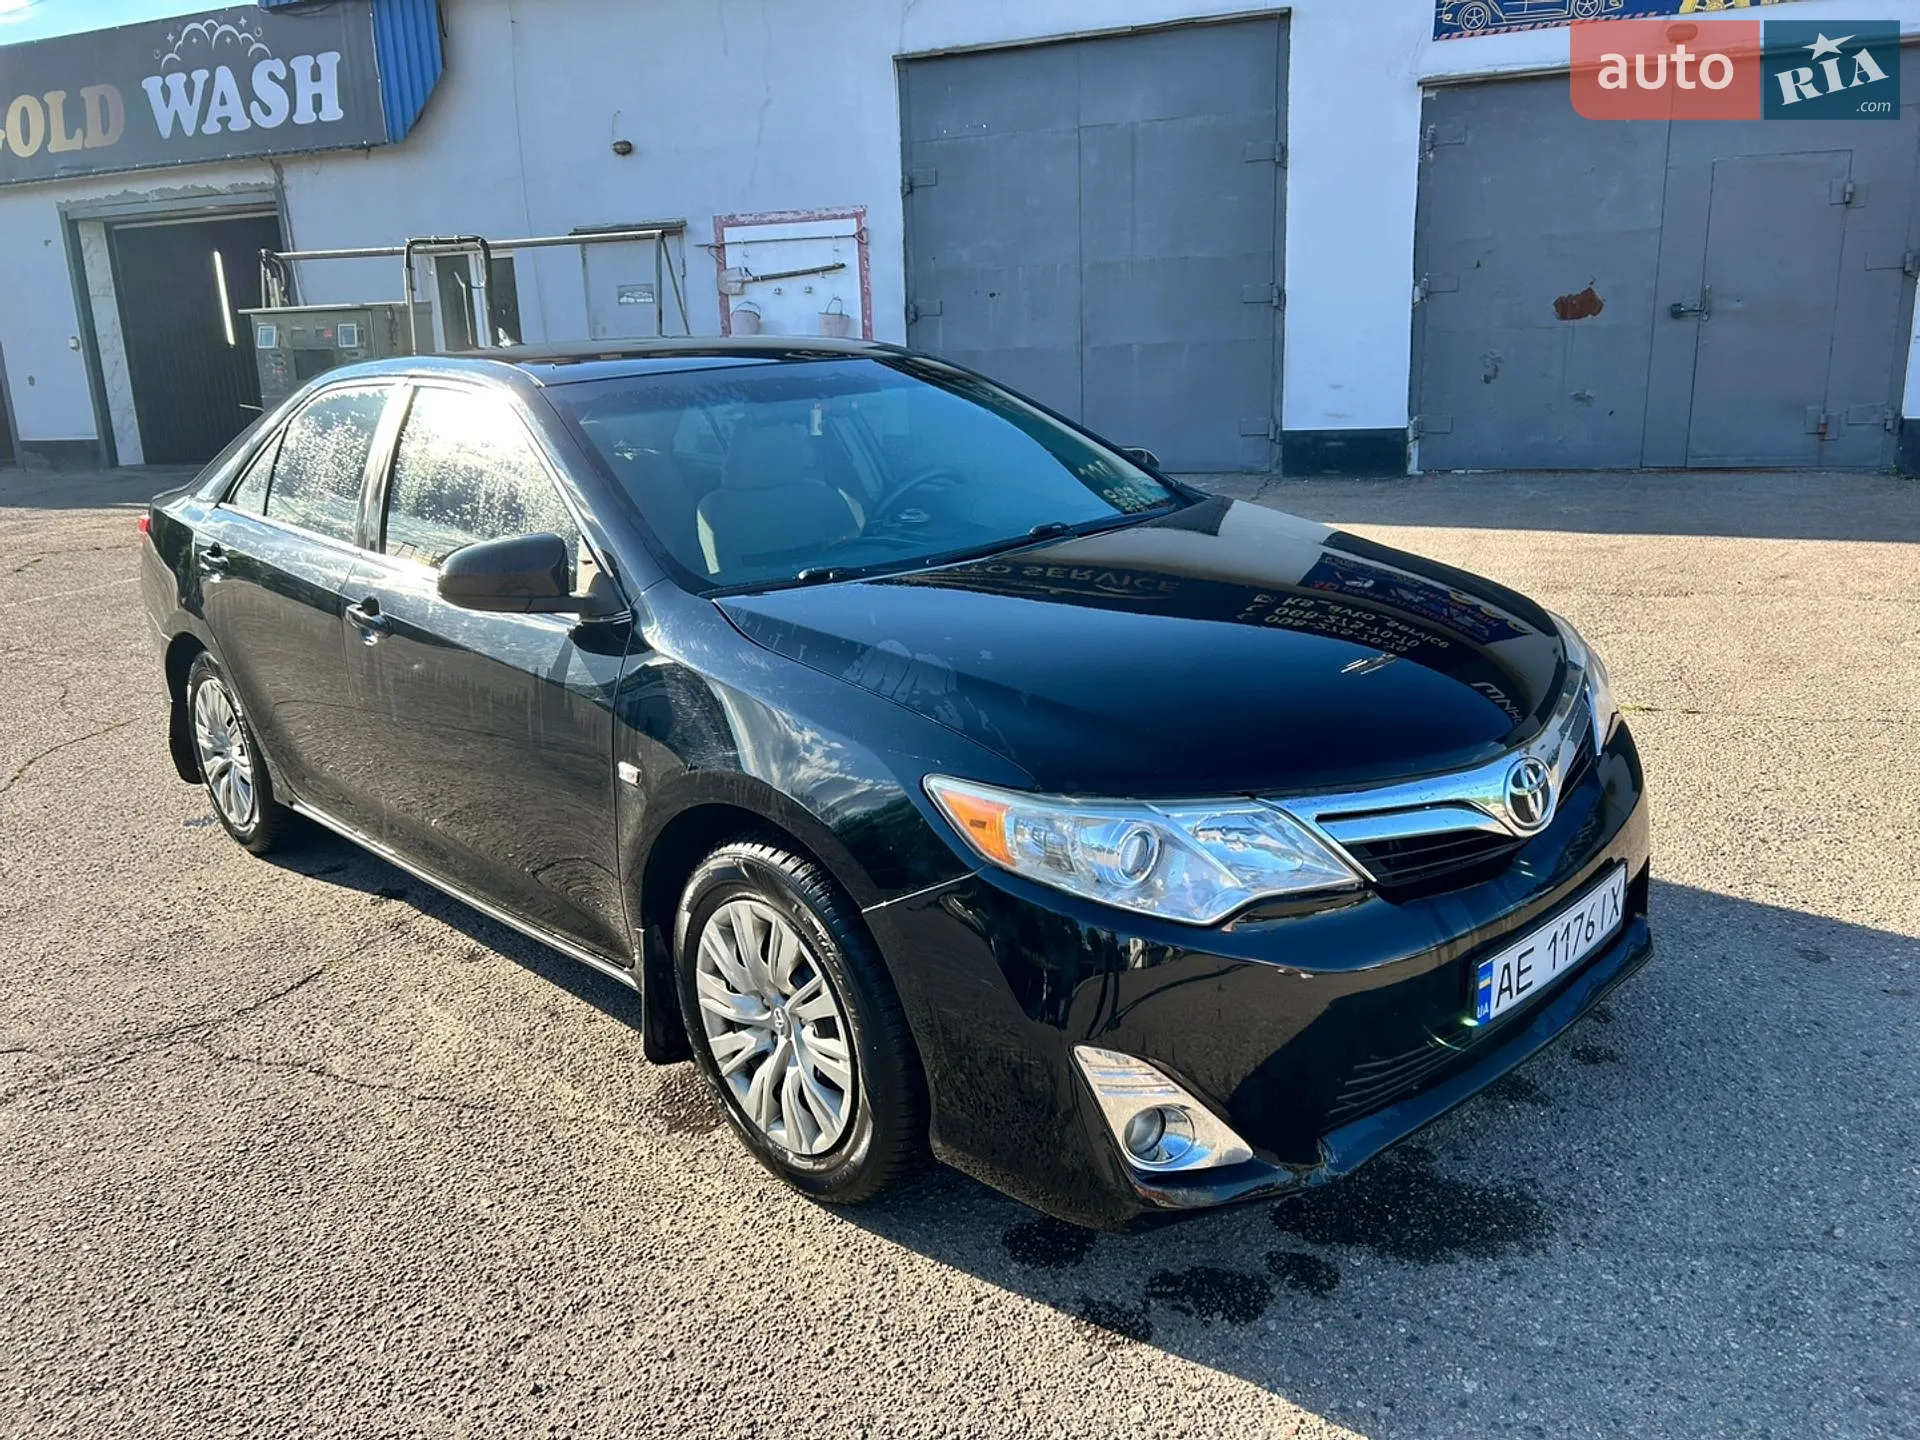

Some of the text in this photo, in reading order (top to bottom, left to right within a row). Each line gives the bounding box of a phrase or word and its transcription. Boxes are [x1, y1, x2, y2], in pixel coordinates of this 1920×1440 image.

[0, 51, 344, 158] OLD WASH
[1495, 878, 1623, 1009] AE 1176 IX
[1477, 1002, 1490, 1018] UA
